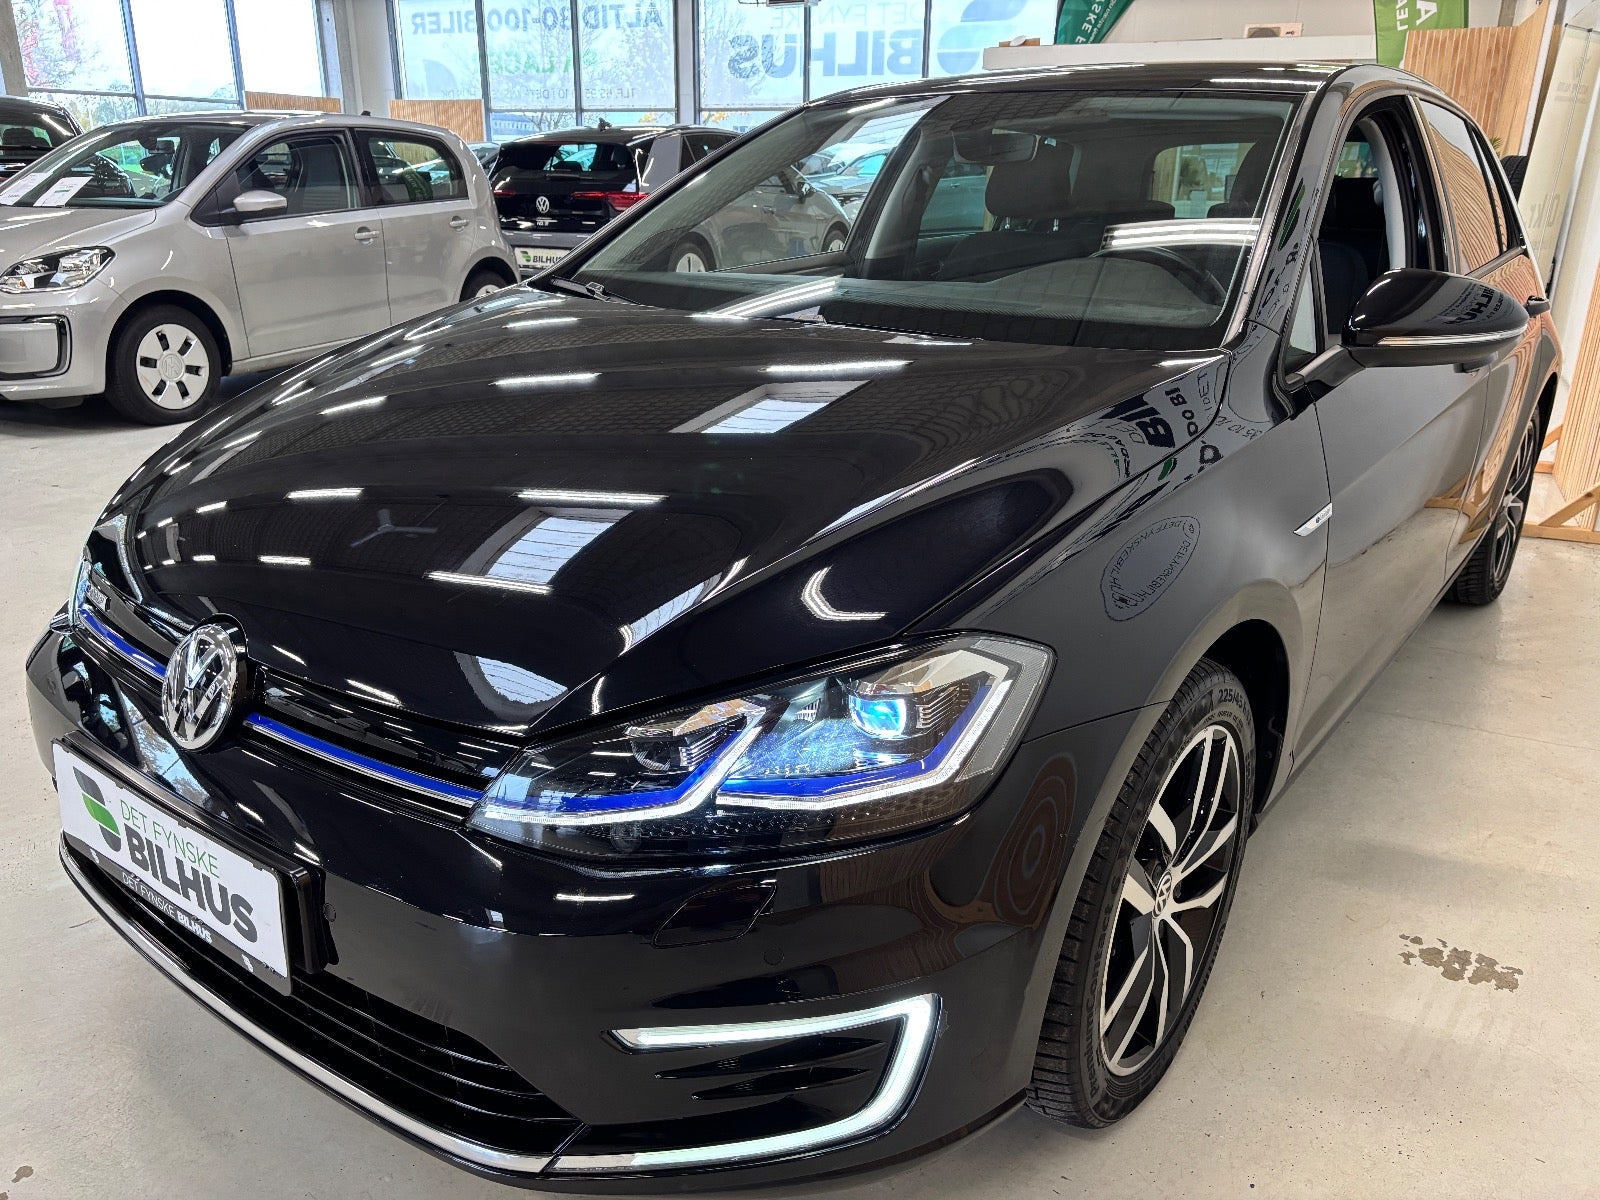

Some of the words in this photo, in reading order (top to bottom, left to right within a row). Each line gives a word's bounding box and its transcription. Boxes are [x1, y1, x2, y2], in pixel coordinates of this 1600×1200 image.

[120, 799, 148, 829] DET
[153, 824, 220, 878] FYNSKE
[122, 871, 140, 893] DET
[140, 886, 175, 918] FYNSKE
[176, 910, 213, 944] BILHUS
[123, 822, 258, 943] BILHUS
